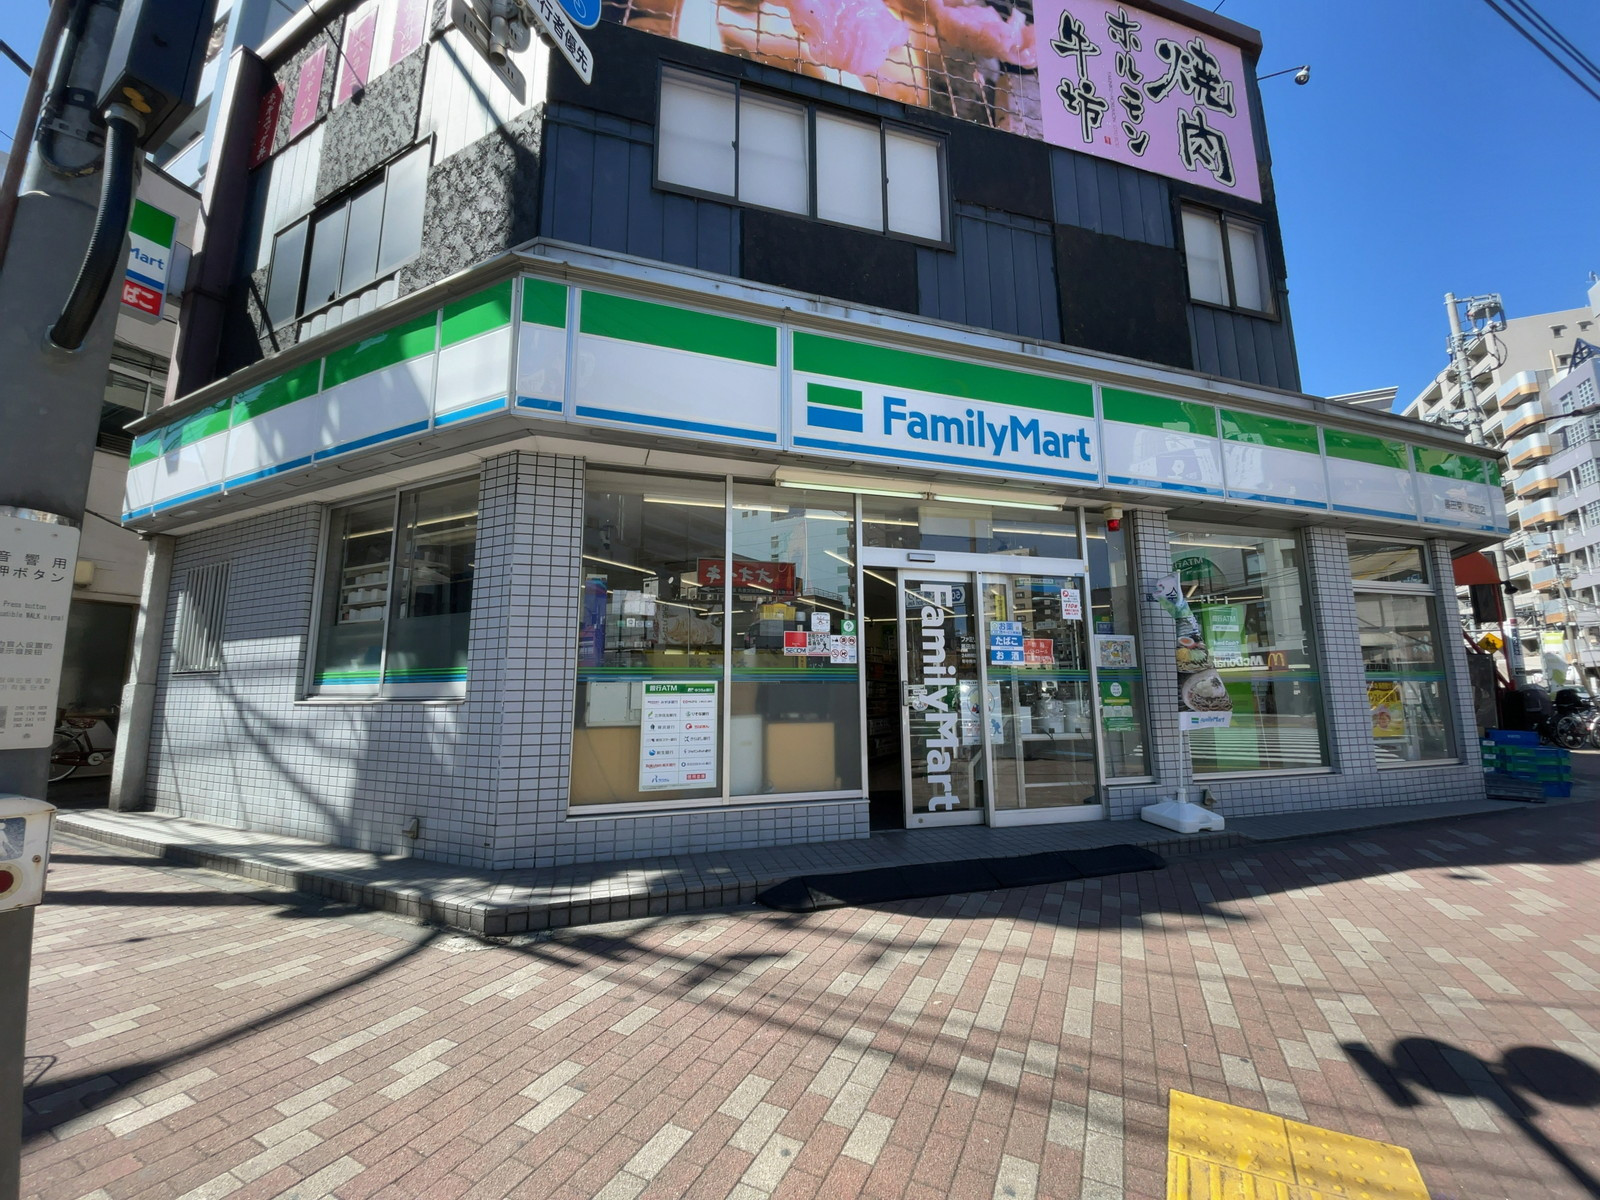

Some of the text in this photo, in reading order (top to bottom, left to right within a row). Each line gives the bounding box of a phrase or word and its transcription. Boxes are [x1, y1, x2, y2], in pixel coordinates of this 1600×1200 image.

[535, 0, 589, 73] 行者優先
[1144, 37, 1236, 188] 焼肉
[123, 284, 154, 310] ばこ
[883, 396, 1091, 462] FamilyMart
[0, 550, 67, 570] 音響用
[995, 636, 1018, 646] たばこ
[996, 651, 1019, 660] お酒
[650, 684, 678, 692] 銀行ATM
[920, 584, 961, 812] FamilyMart
